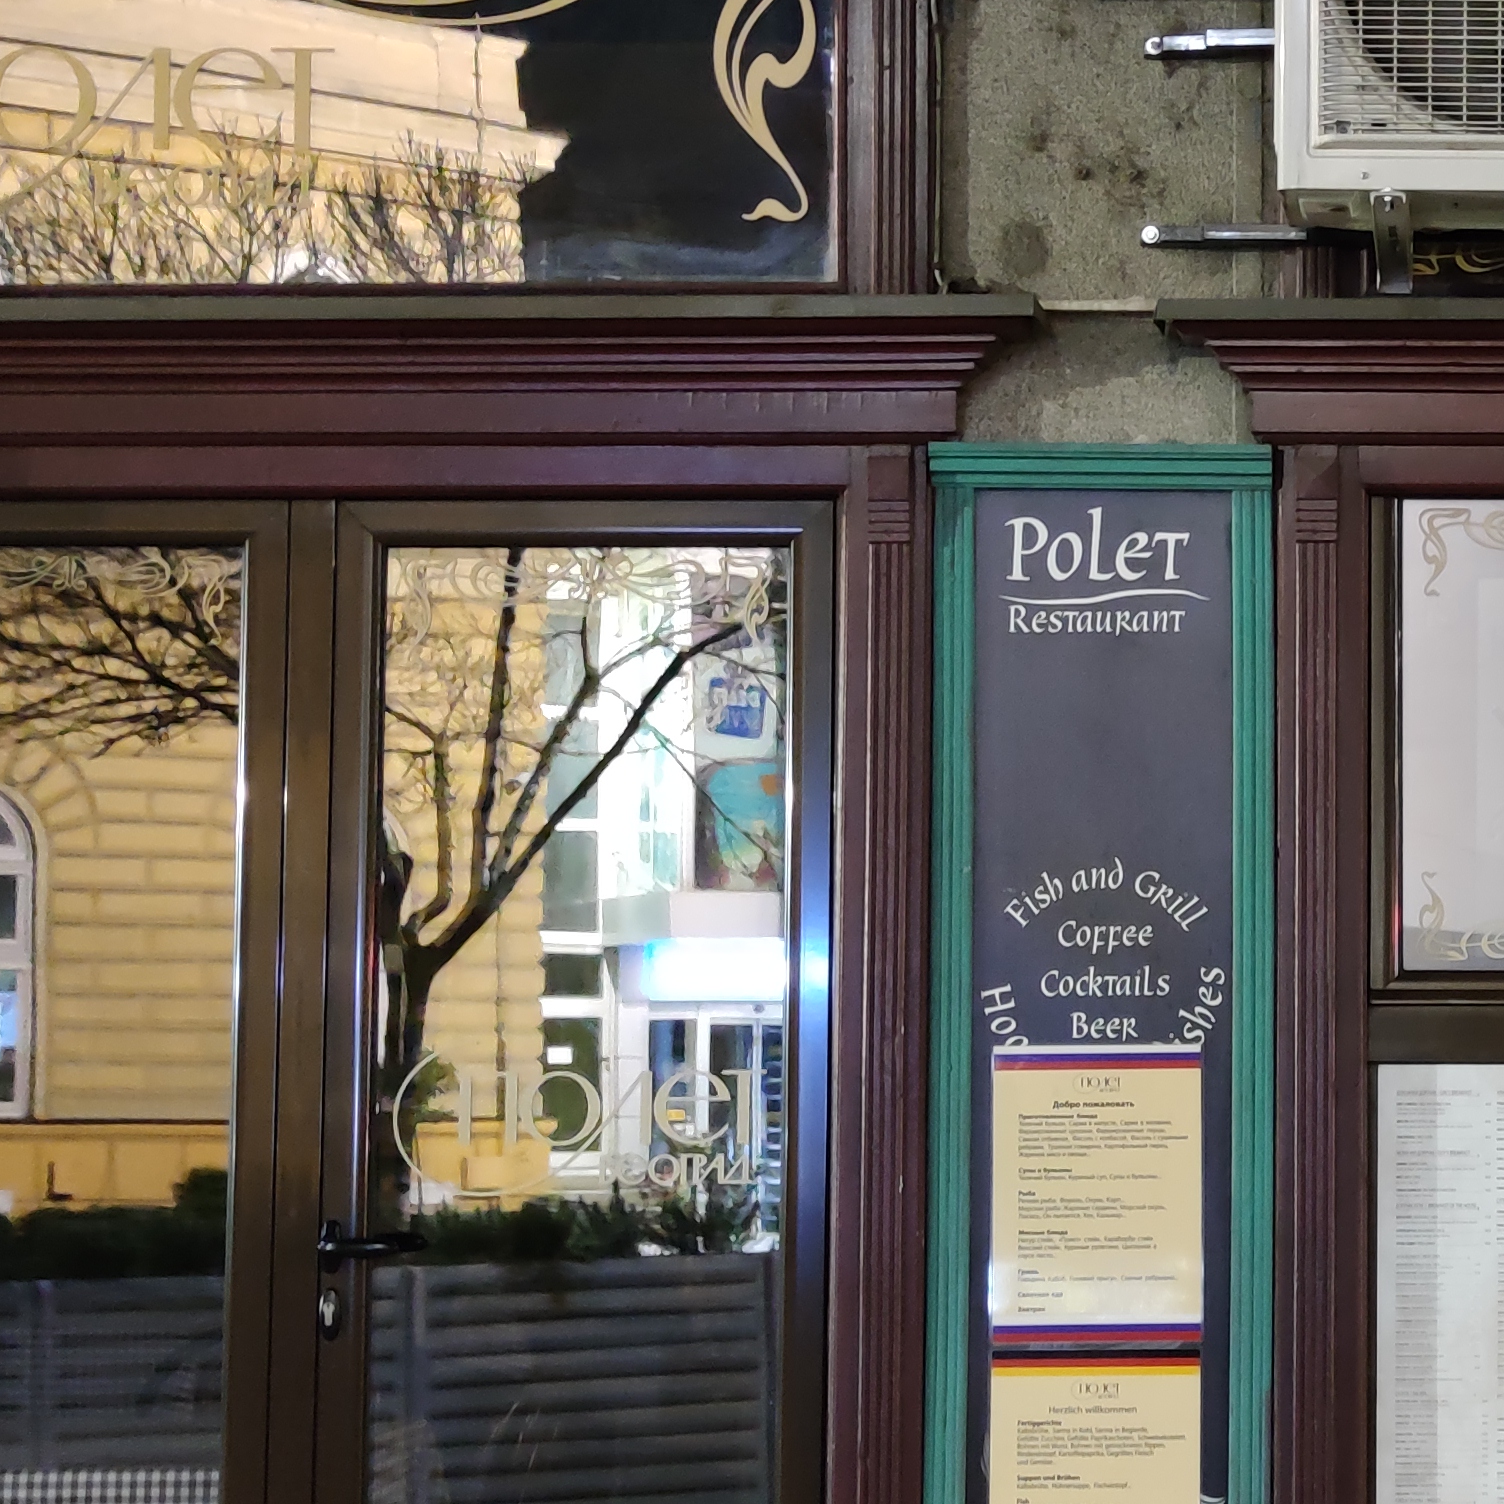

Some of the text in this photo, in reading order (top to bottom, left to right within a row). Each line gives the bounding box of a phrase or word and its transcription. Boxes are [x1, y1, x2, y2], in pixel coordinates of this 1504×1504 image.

[1004, 857, 1209, 932] Fish and Grill
[1057, 920, 1154, 955] Coffee
[1040, 965, 1171, 997] Cocktails
[1070, 1011, 1139, 1042] Beer
[1048, 1406, 1138, 1414] Herzlich willkommen
